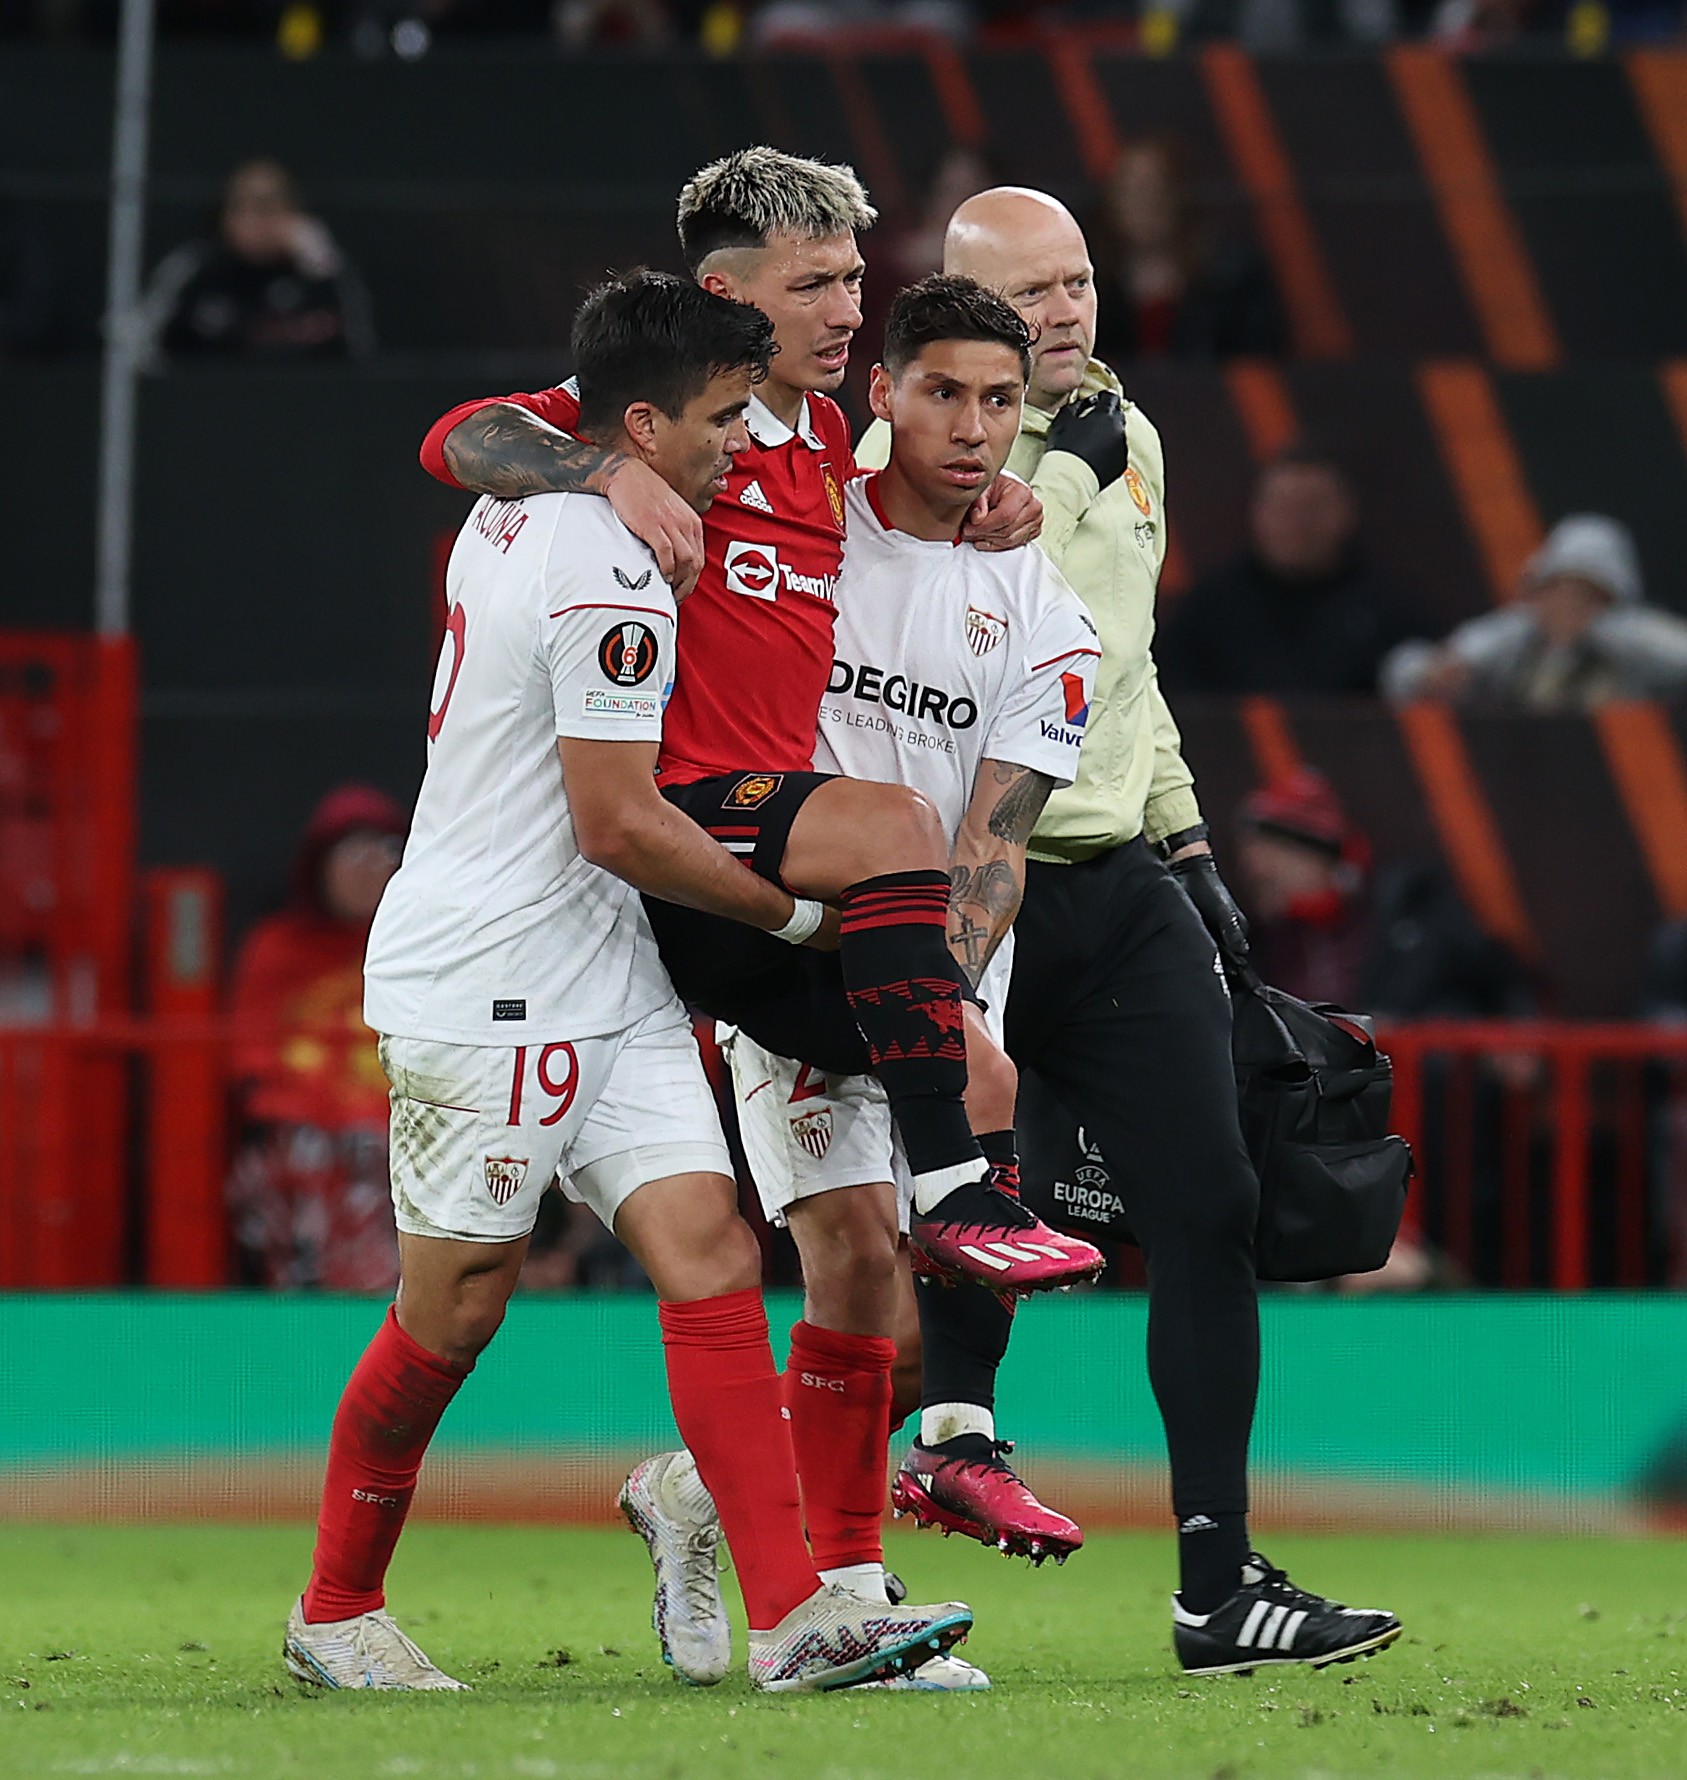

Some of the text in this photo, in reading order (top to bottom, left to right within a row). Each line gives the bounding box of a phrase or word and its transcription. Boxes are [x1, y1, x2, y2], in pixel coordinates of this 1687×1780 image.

[740, 494, 774, 513] adidas
[778, 563, 836, 601] TeamV
[622, 646, 638, 665] 6
[585, 698, 656, 710] FOUNDATION
[826, 659, 978, 729] DEGIRO
[907, 731, 958, 755] BROKE
[506, 1041, 579, 1127] 19
[1076, 1169, 1107, 1188] UEFA
[1054, 1182, 1126, 1214] EUROPA
[1068, 1204, 1110, 1223] LEAGUE
[801, 1372, 845, 1392] SFC
